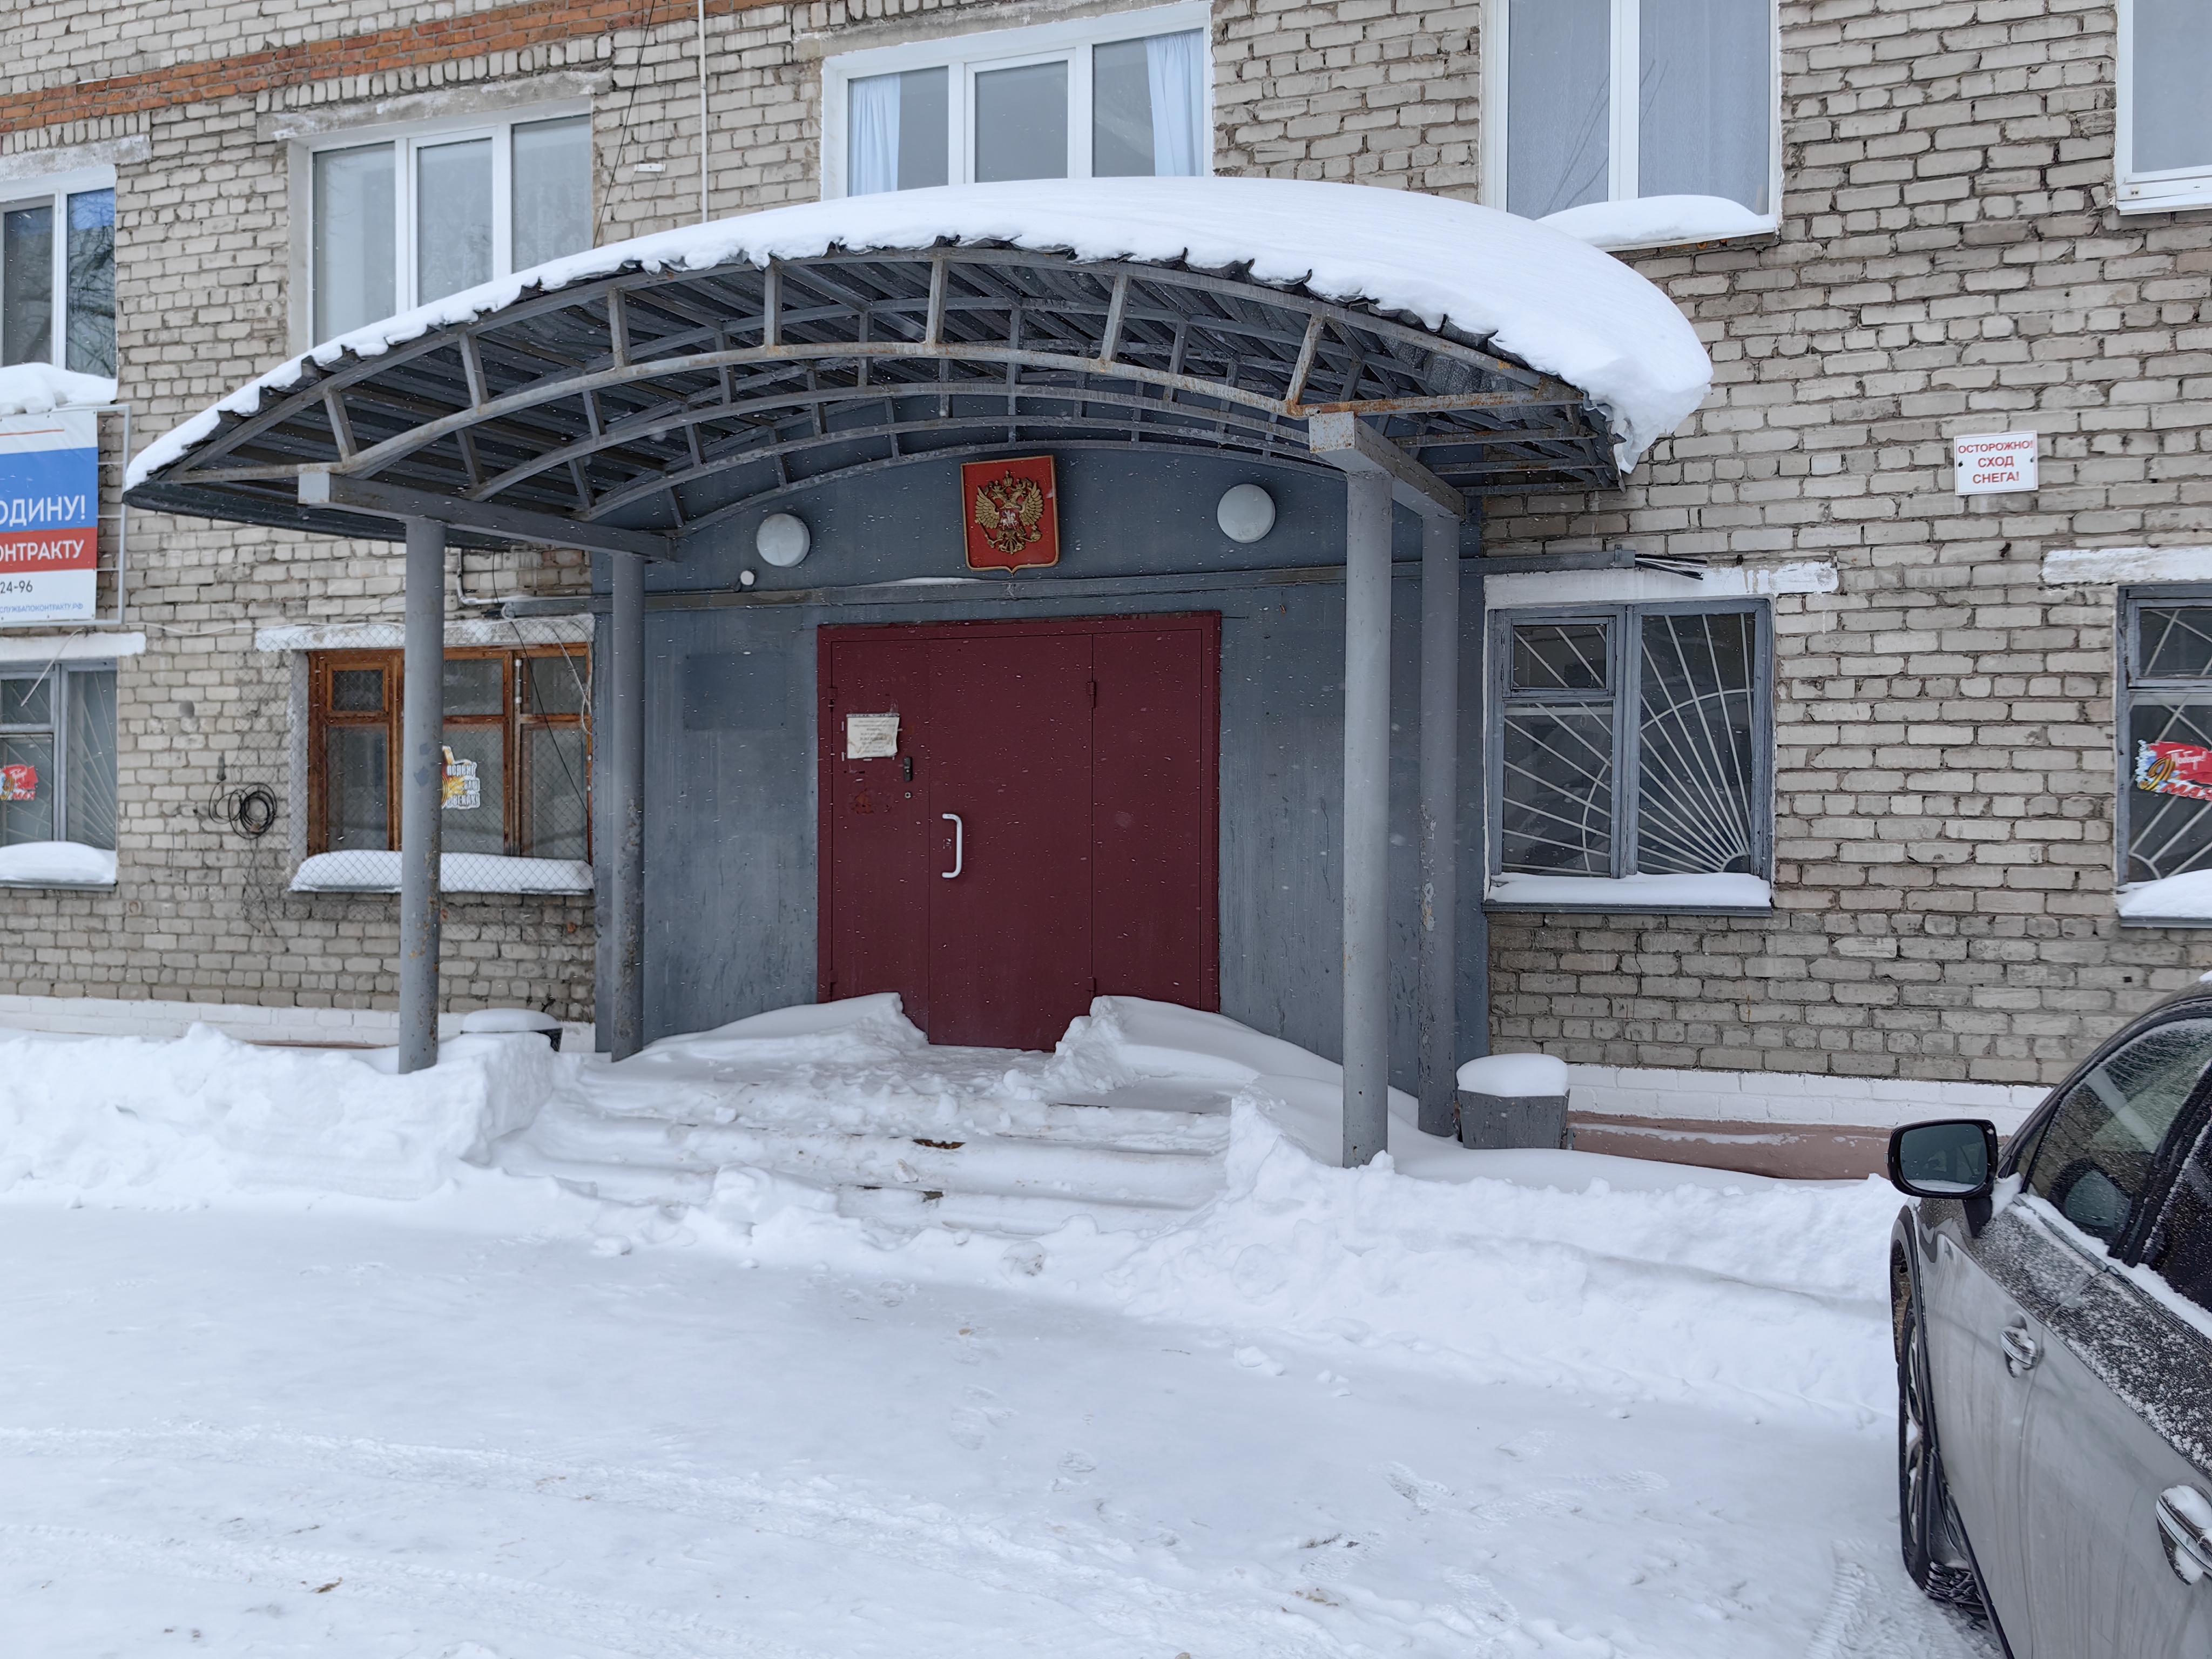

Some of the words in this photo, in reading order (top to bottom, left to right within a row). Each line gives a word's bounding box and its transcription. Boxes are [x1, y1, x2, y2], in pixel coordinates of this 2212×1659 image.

[1958, 440, 2033, 454] ОСТОРОЖНО!
[1978, 456, 2014, 468] СХОД
[1973, 471, 2019, 484] СНЕГА!
[0, 579, 33, 594] 24-96
